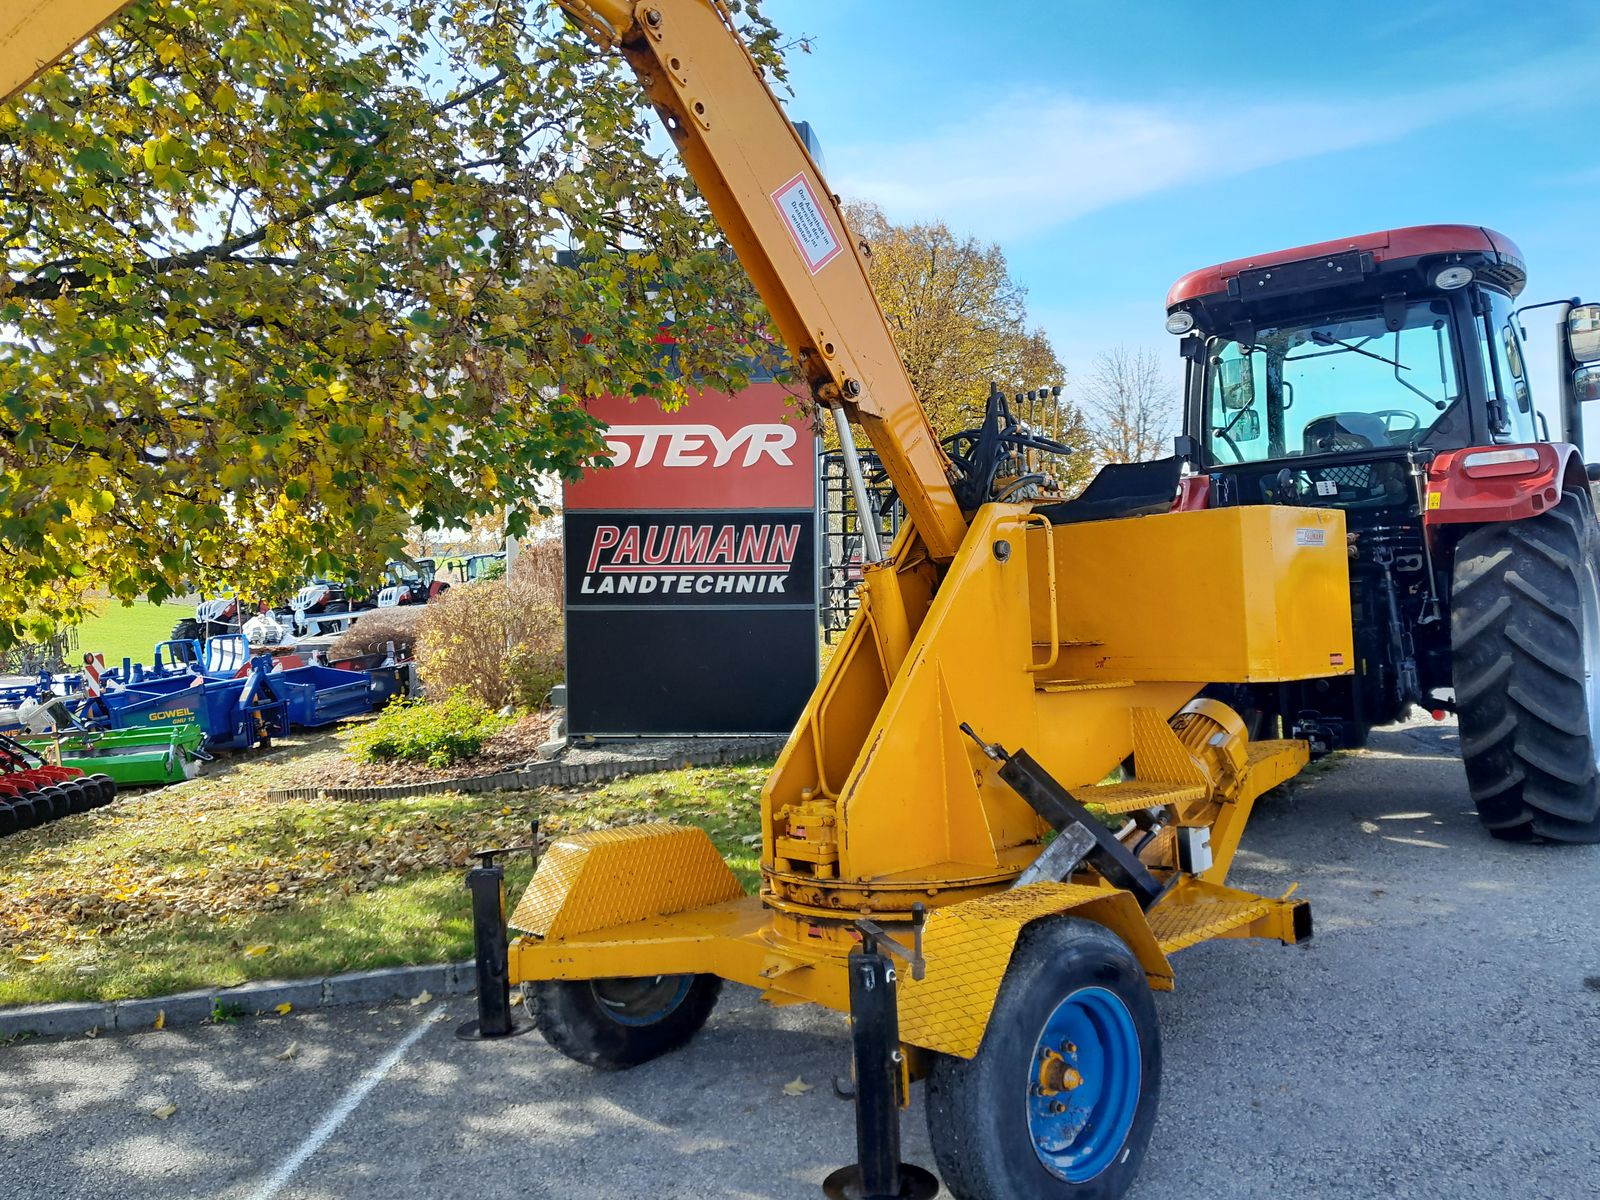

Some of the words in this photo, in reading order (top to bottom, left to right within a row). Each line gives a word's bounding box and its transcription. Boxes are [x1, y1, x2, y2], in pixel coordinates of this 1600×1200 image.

[791, 201, 812, 238] Drehkranes
[798, 189, 806, 201] Der
[805, 202, 825, 235] Aufenthalt
[798, 201, 813, 227] Bereich
[791, 214, 810, 244] verboten!
[586, 525, 801, 573] PAUMANN
[580, 575, 789, 594] LANDTECHNIK
